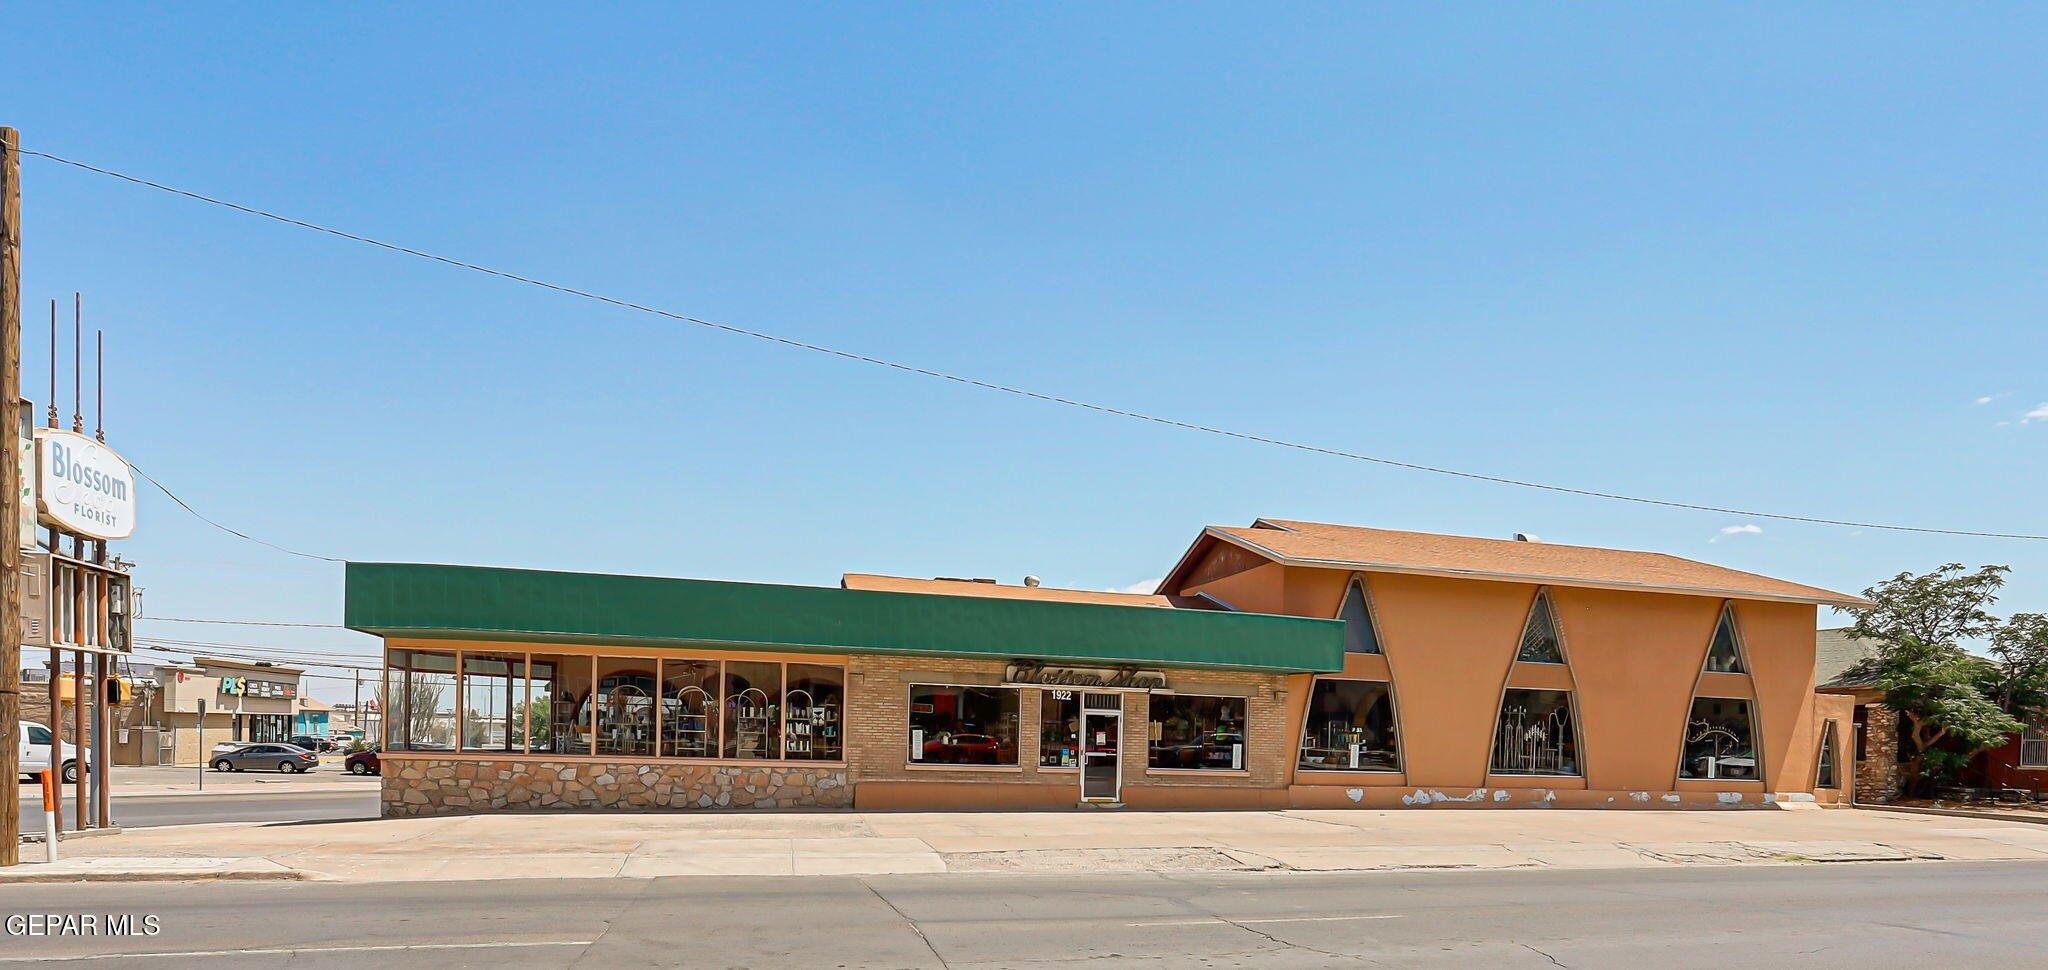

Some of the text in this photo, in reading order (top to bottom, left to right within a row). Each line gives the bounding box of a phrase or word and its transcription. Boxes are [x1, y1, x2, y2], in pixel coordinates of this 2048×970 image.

[52, 441, 127, 502] Blossom
[74, 503, 117, 527] FLORIST
[1051, 690, 1072, 701] 1922
